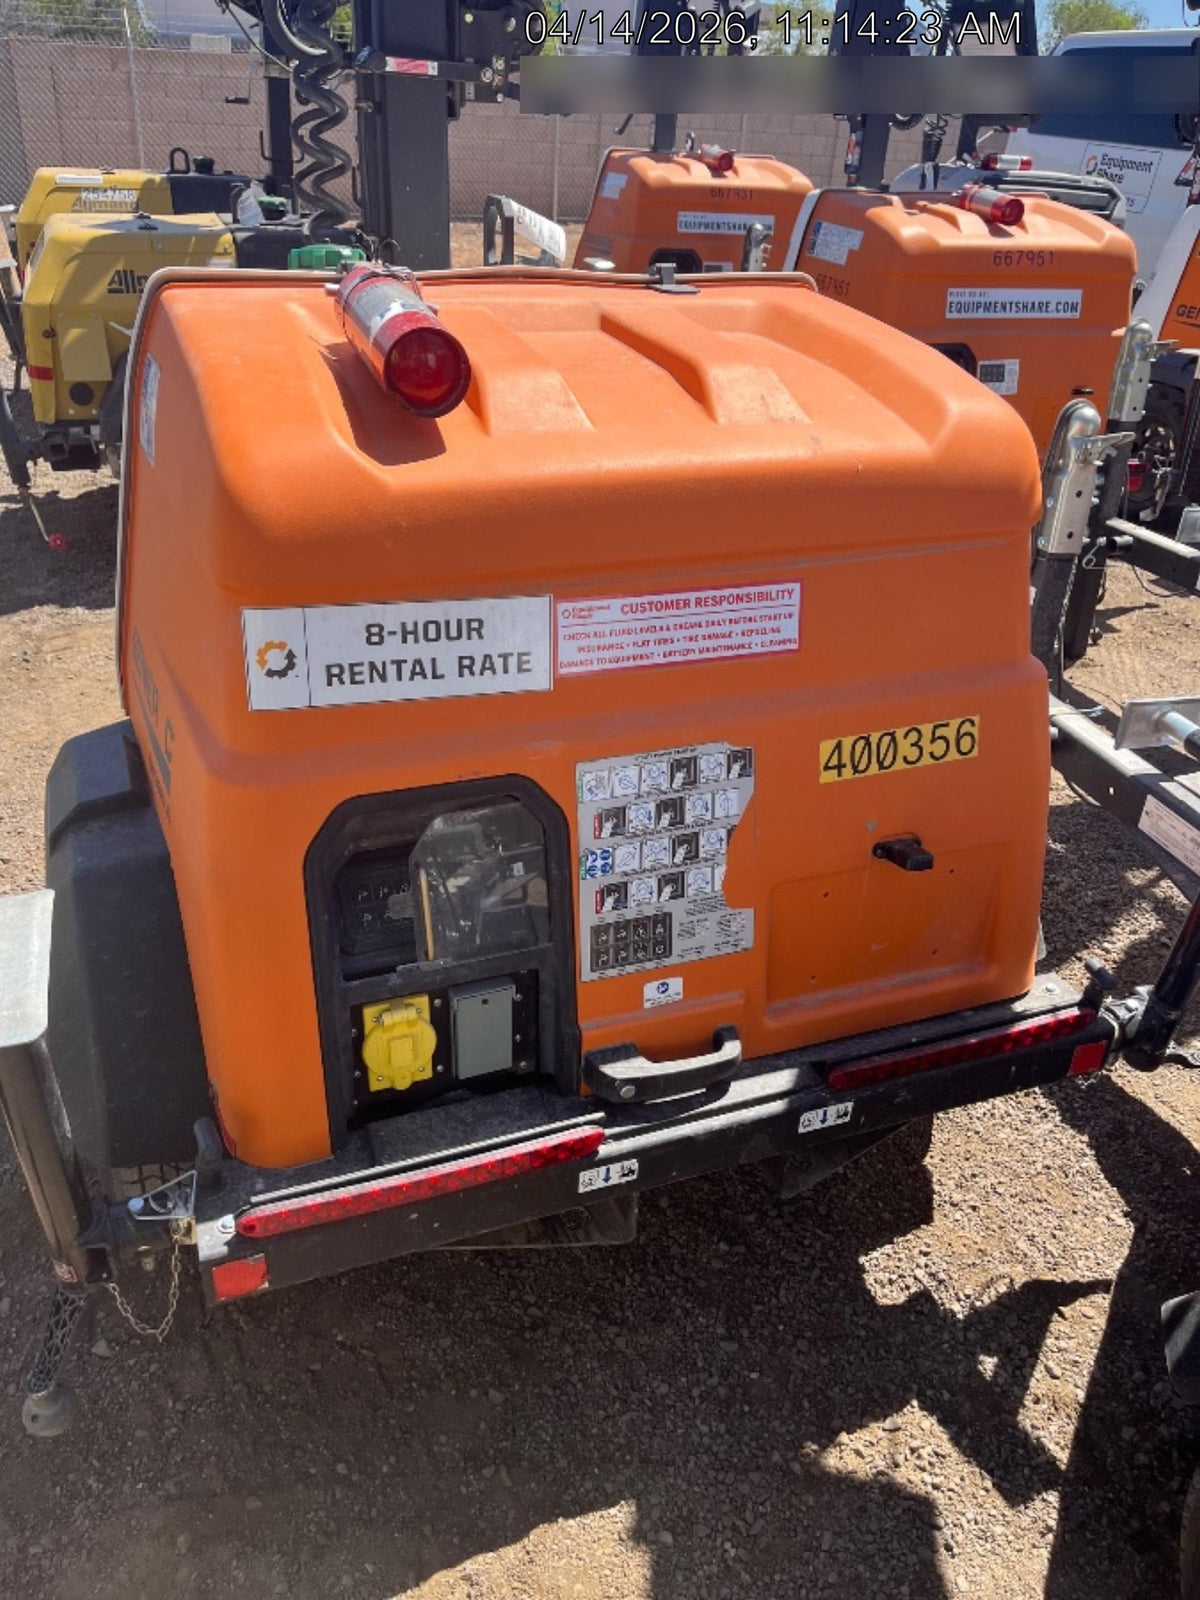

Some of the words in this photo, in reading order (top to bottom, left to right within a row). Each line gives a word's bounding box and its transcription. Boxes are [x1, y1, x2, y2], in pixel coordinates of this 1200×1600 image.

[1100, 153, 1153, 173] Equipment
[1096, 168, 1124, 184] Share
[993, 250, 1054, 267] 667951
[948, 301, 1080, 314] EQUIPMENTSHARE.COM
[620, 598, 691, 616] CUSTOMER
[694, 588, 795, 609] RESPONSIBILITY
[365, 618, 485, 646] 8-HOUR
[326, 657, 445, 687] RENTAL
[457, 651, 532, 678] RATE
[822, 717, 977, 778] 400356
